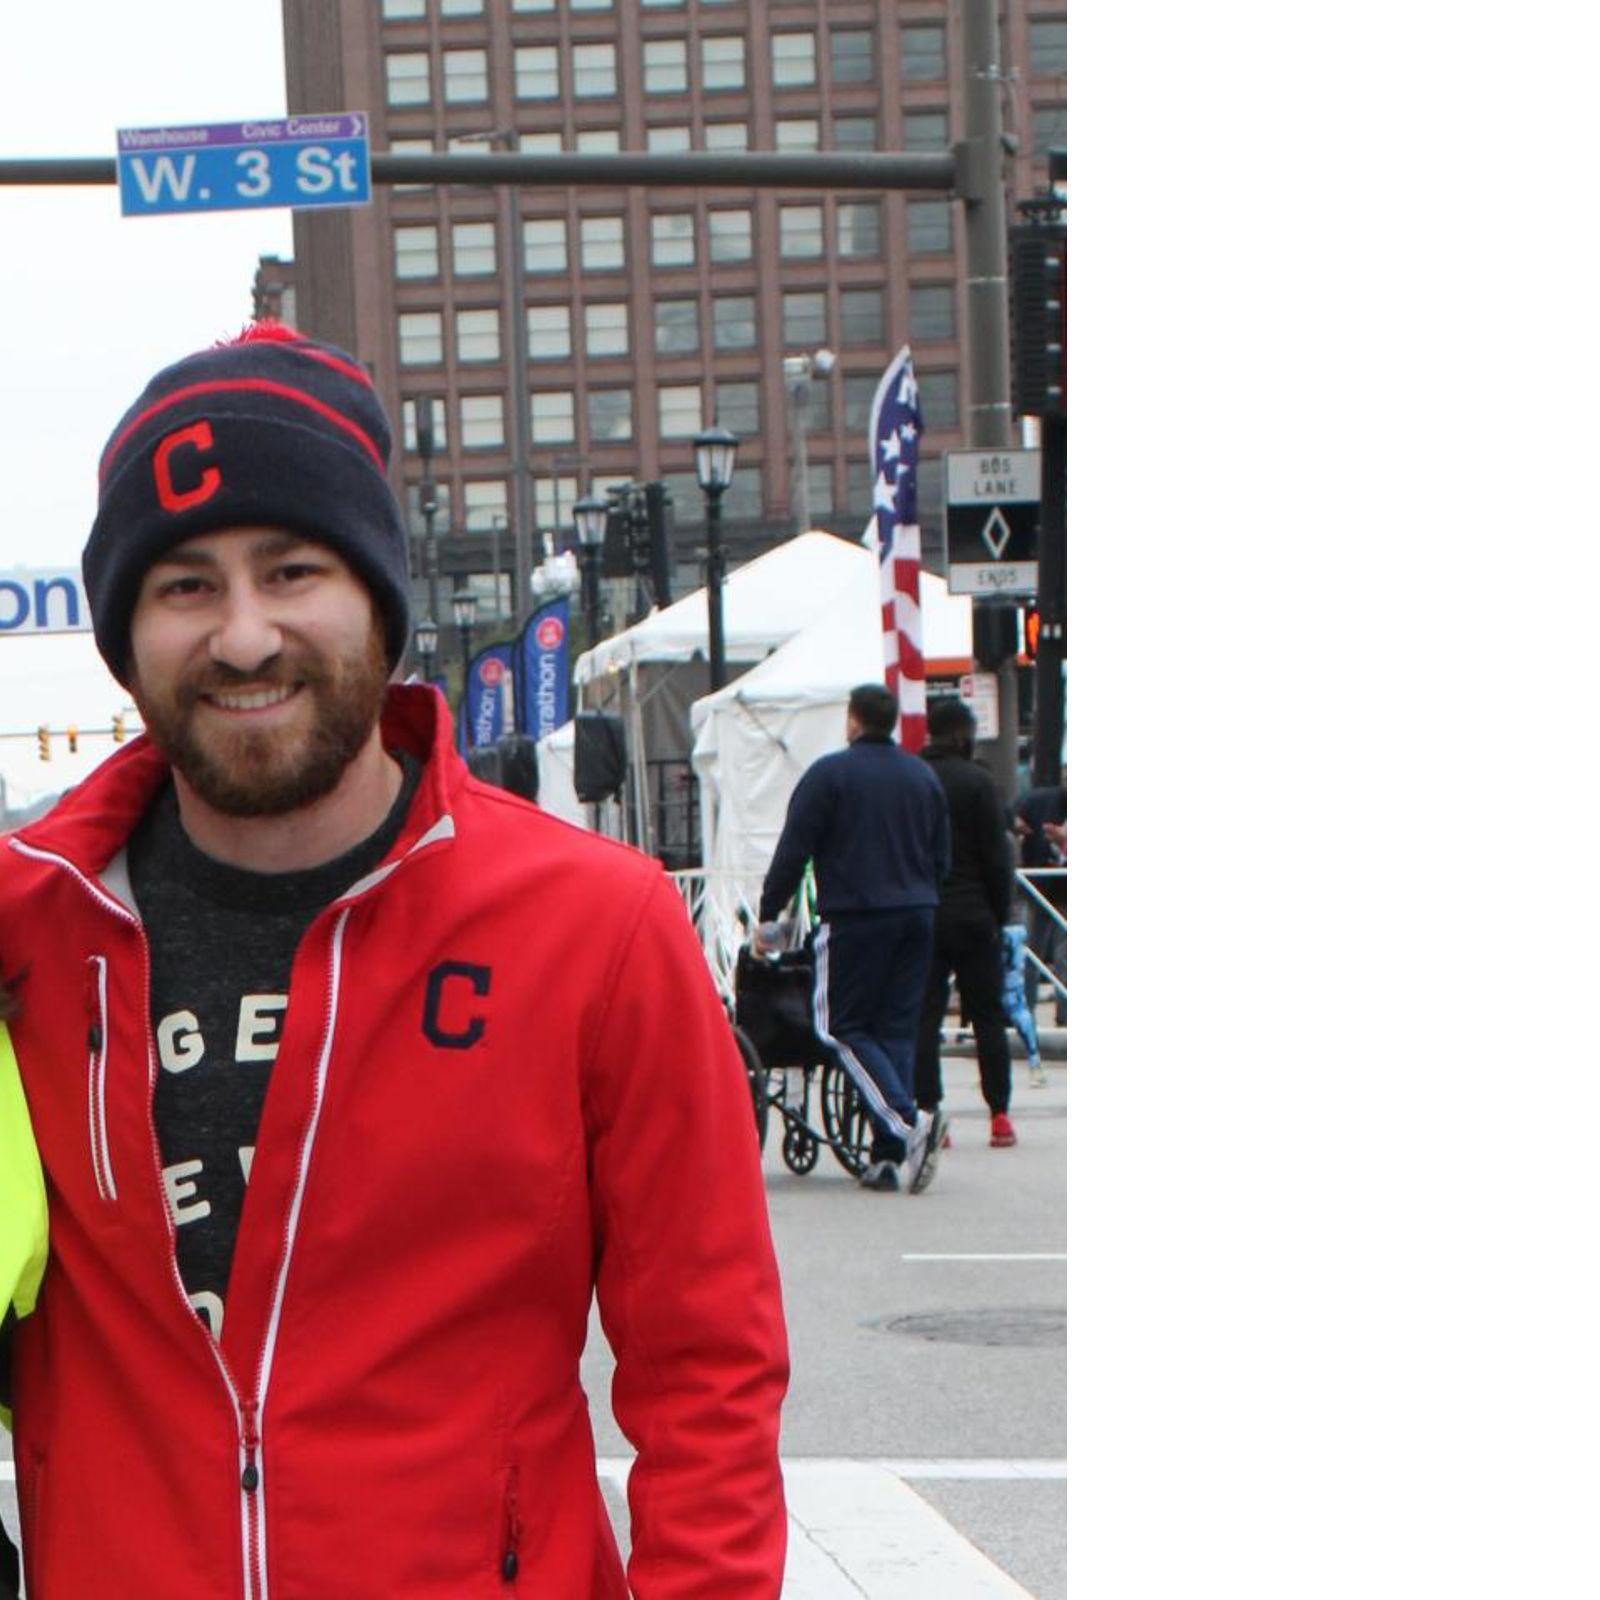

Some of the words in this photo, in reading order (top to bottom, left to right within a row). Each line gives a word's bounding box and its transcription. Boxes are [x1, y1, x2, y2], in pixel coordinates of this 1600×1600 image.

[121, 128, 208, 147] Warehouse
[241, 121, 282, 139] Civic
[286, 117, 342, 137] Center
[131, 154, 210, 203] W.
[234, 150, 272, 198] 3
[296, 147, 357, 193] St
[153, 419, 222, 514] C
[974, 479, 1017, 496] LANE
[978, 569, 1018, 586] ENDS
[421, 960, 492, 1049] C
